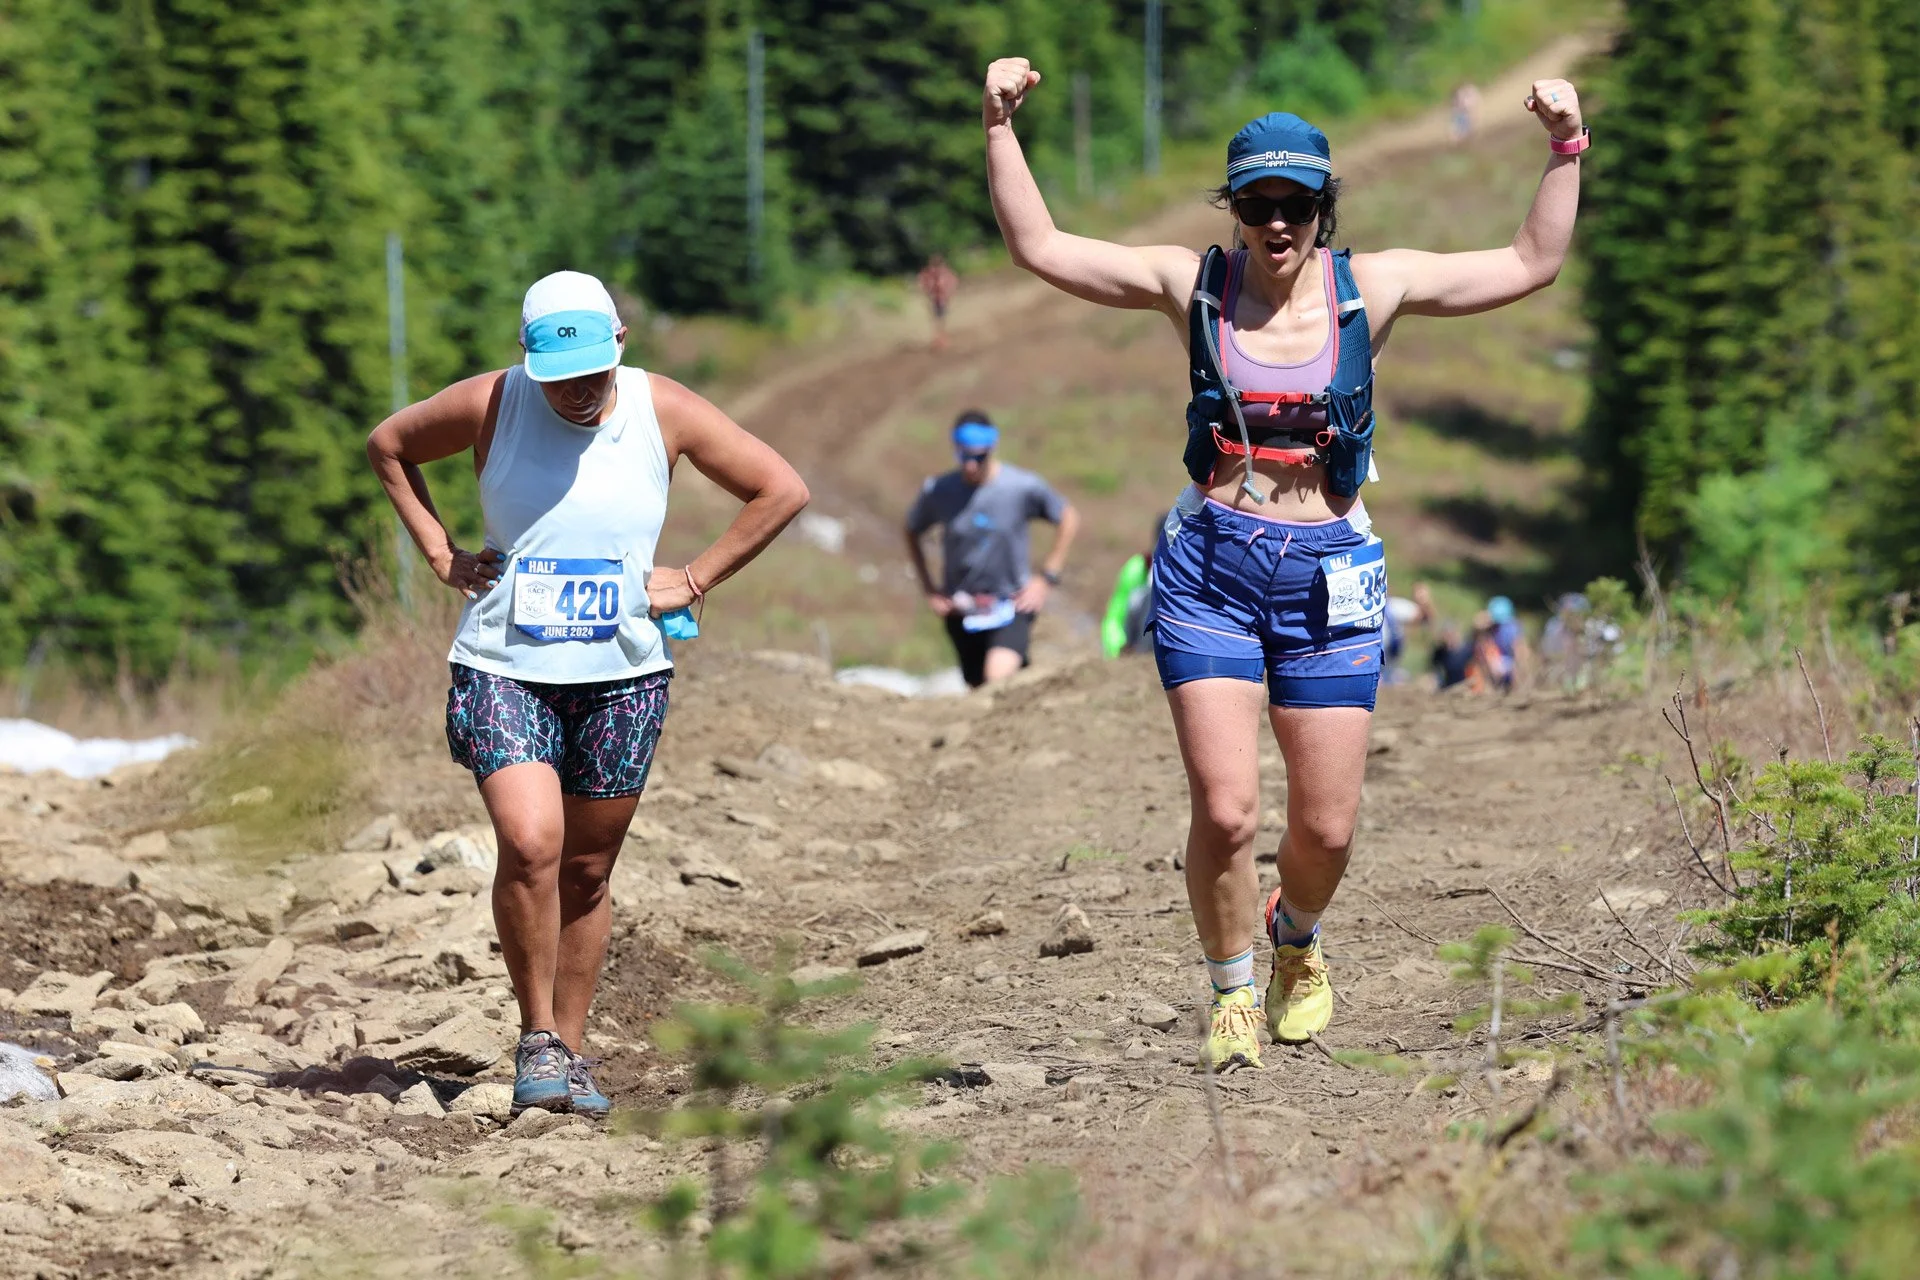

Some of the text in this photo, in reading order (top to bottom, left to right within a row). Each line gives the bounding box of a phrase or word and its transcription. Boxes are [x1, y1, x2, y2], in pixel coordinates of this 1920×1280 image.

[1265, 150, 1289, 160] RUN
[557, 326, 577, 338] OR
[528, 560, 558, 574] HALF
[1329, 553, 1353, 572] HALF
[555, 580, 619, 621] 420
[541, 626, 594, 637] JUNE 2024
